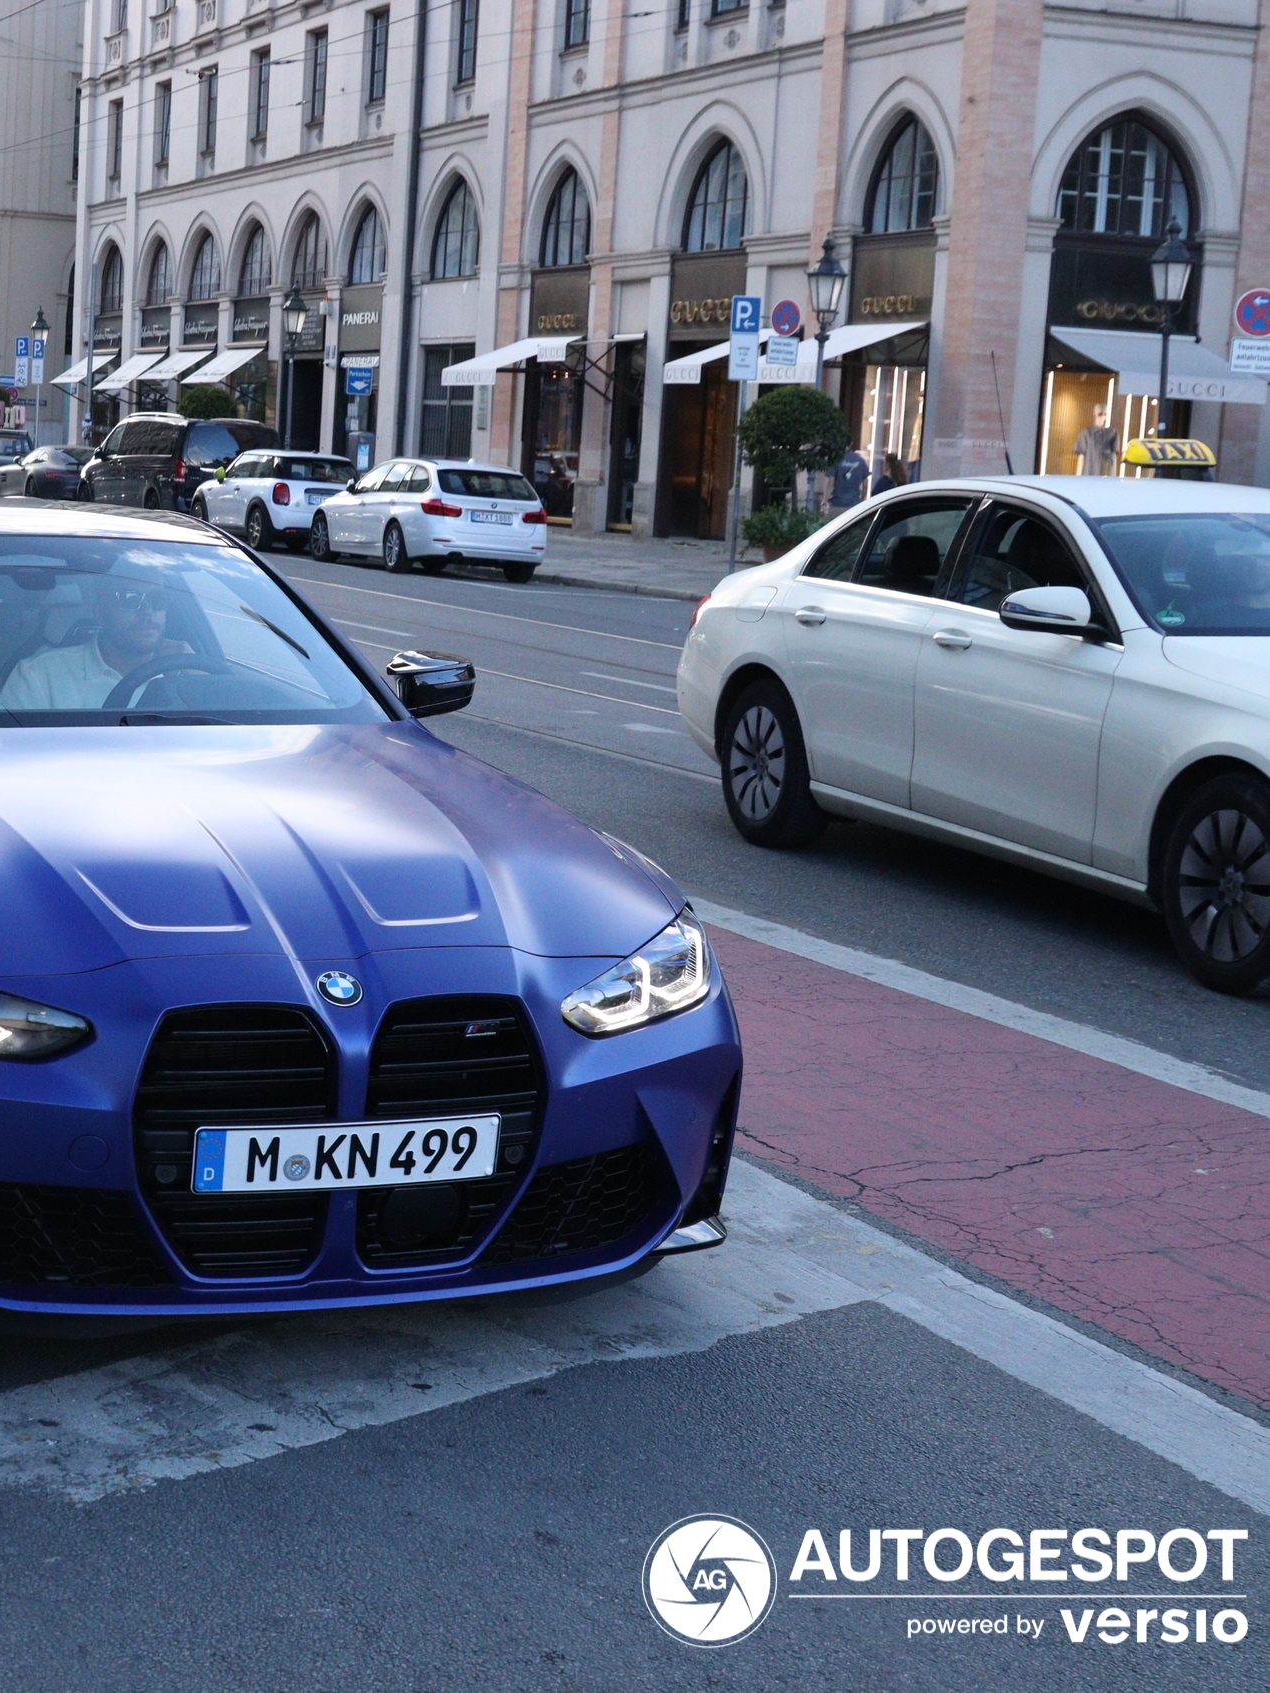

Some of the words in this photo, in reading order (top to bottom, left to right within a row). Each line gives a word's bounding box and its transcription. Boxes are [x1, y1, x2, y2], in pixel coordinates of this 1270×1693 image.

[670, 299, 731, 323] GUCC
[860, 295, 915, 314] GUCCI
[342, 311, 379, 326] PANERAI
[537, 313, 577, 330] GUCCI
[735, 301, 752, 329] P
[539, 347, 565, 359] GUCCI
[455, 372, 481, 383] GUCCI
[665, 367, 699, 379] GUCCI
[761, 366, 796, 379] GUCCI
[1146, 441, 1207, 461] TAXI
[320, 971, 356, 983] BMW
[246, 1136, 280, 1183] M
[314, 1131, 380, 1180] KN
[389, 1125, 478, 1176] 499
[203, 1167, 215, 1181] D
